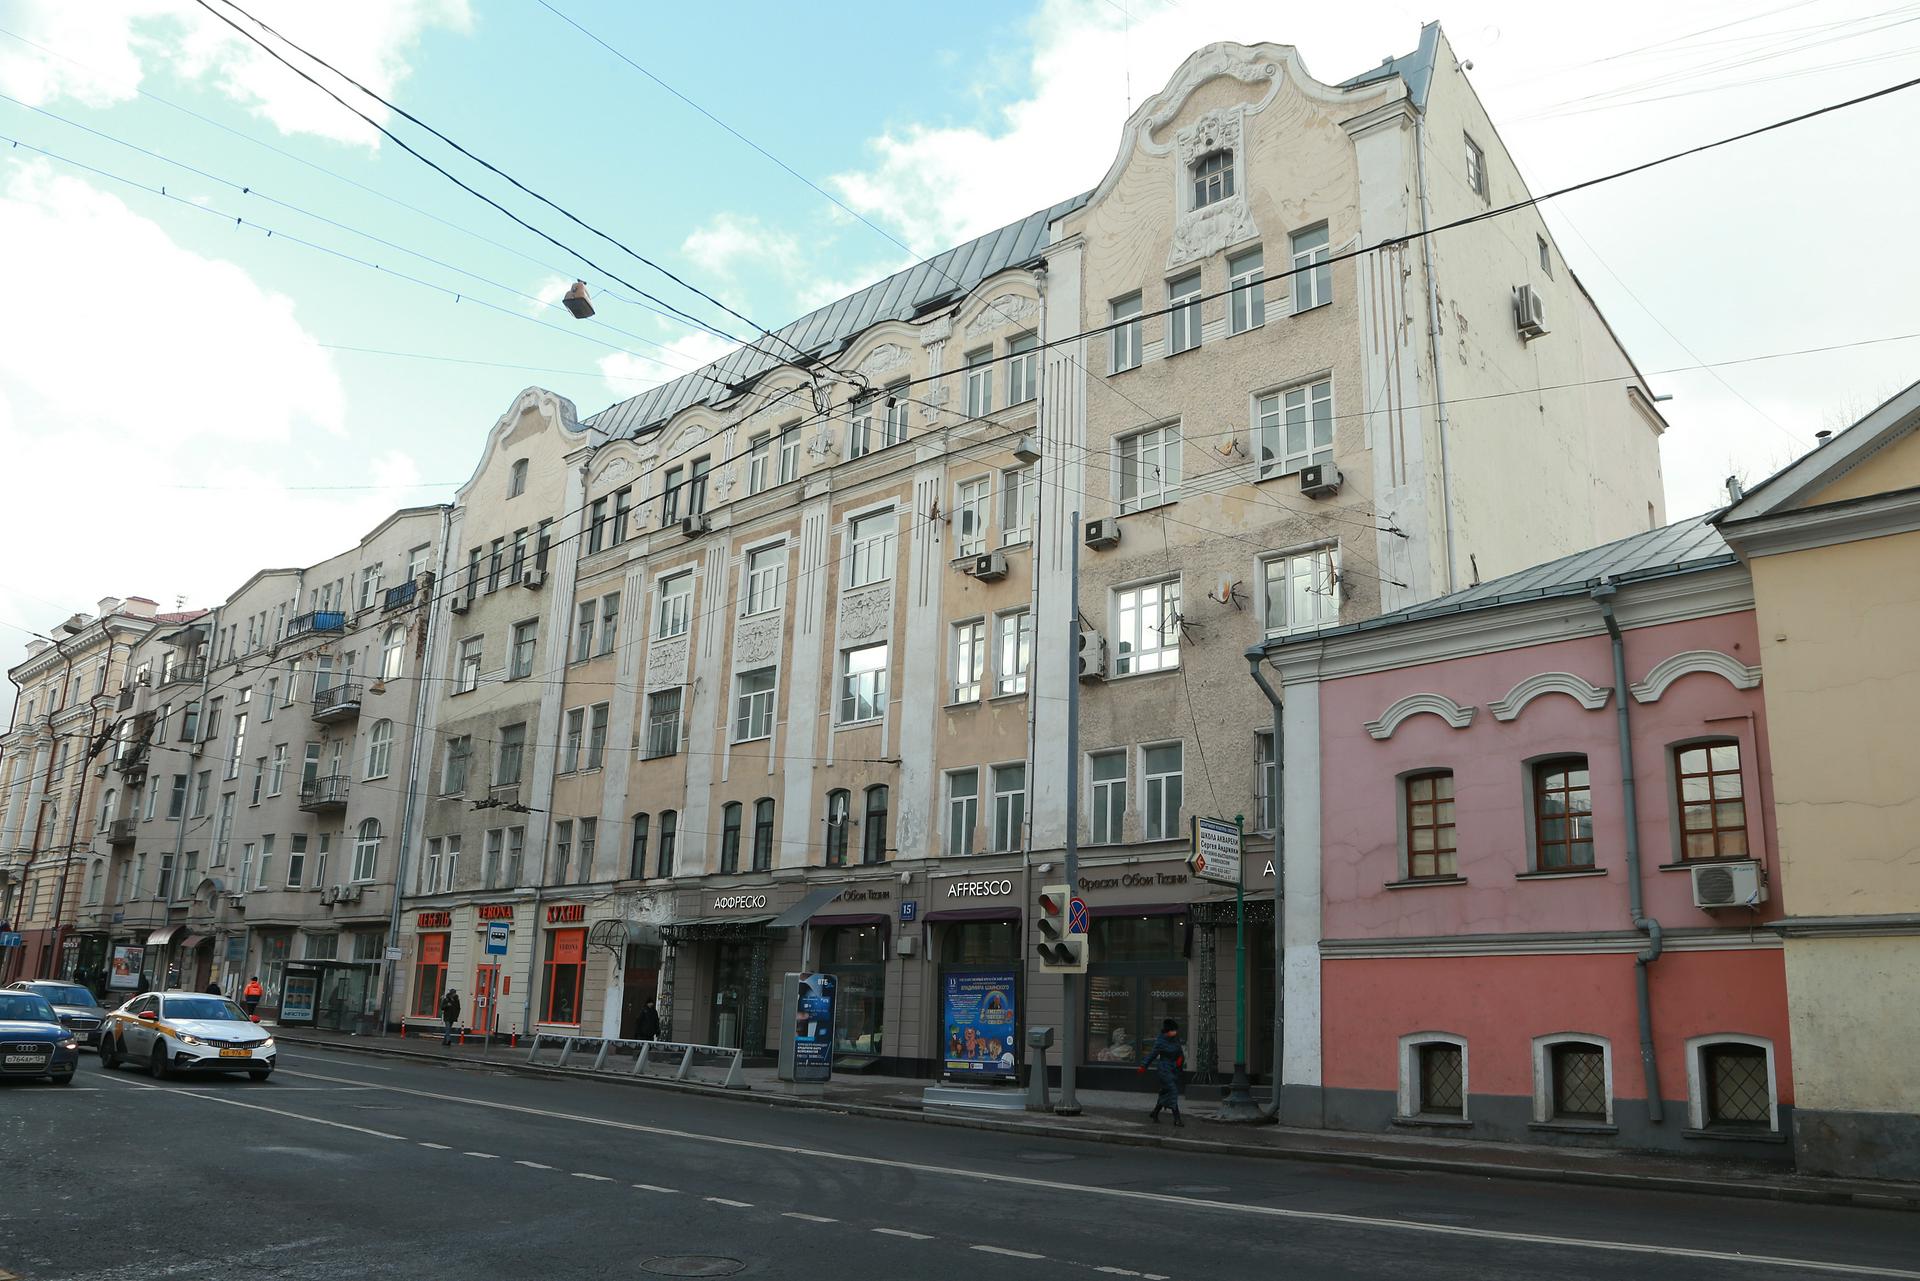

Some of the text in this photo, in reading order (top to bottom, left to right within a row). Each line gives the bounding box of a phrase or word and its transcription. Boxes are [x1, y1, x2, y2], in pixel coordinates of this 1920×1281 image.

[948, 880, 1012, 898] AFFRESCO
[1078, 872, 1187, 892] Фрески Обои Ткани
[714, 894, 766, 909] АФФРЕСКО
[903, 904, 912, 914] 15
[417, 912, 452, 928] МЕБЕЛЬ
[547, 904, 586, 922] КУХНИ
